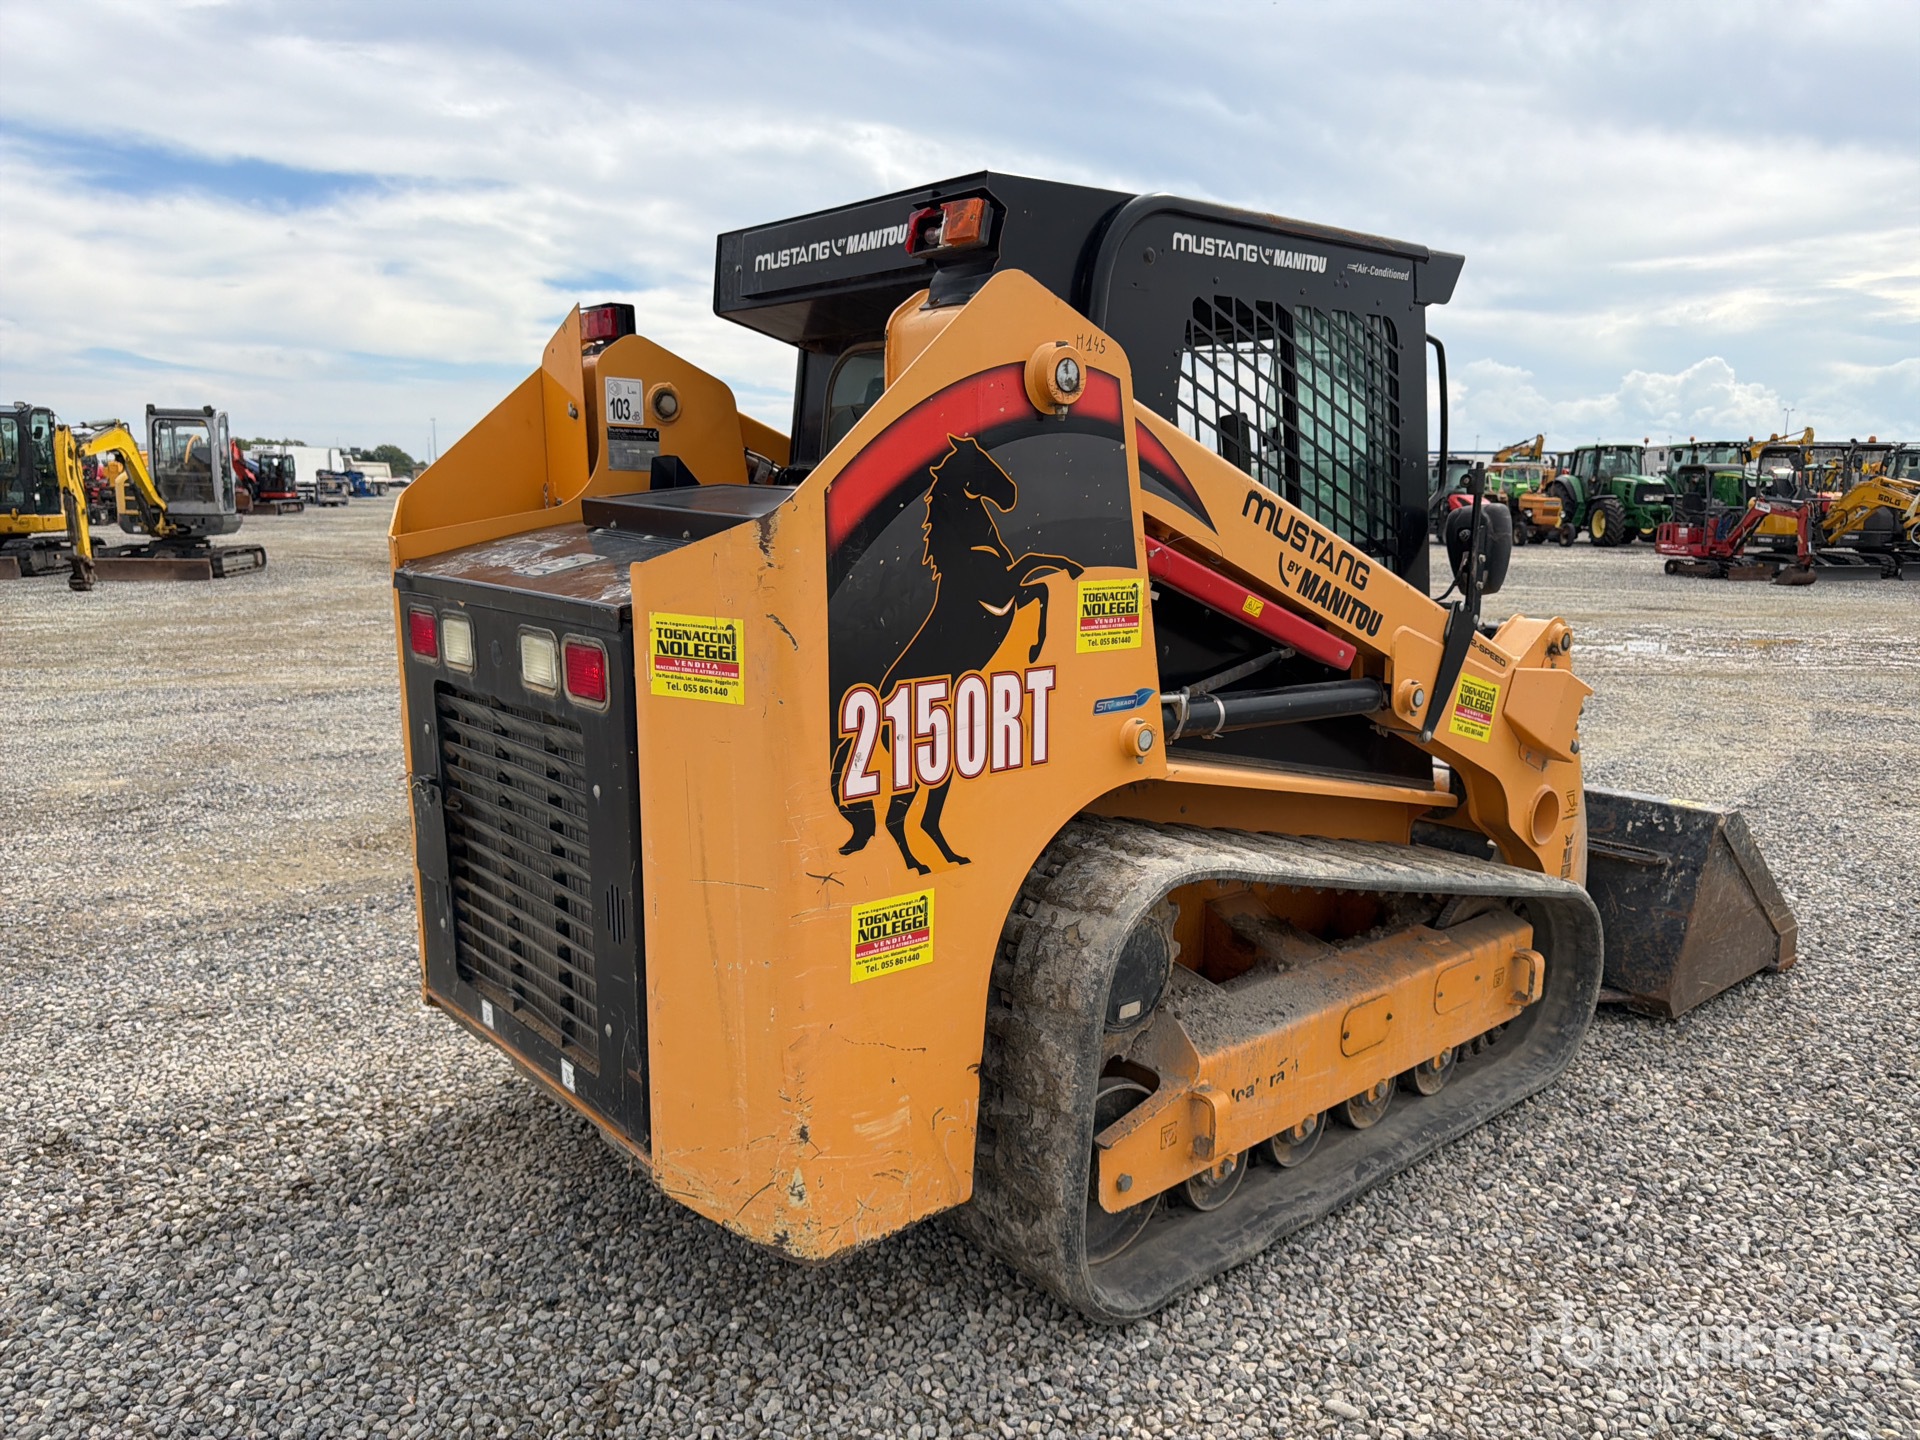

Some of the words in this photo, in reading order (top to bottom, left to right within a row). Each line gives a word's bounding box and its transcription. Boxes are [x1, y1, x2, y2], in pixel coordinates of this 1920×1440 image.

[754, 240, 830, 272] MUSTANG
[838, 238, 847, 247] BY
[846, 223, 909, 255] MANITOU
[1172, 231, 1258, 263] MUSTANG
[1264, 248, 1273, 257] BY
[1273, 249, 1328, 274] MANITOU
[1357, 263, 1410, 281] Air-Conditioned
[609, 397, 631, 420] 103
[1241, 489, 1371, 592] MUSTANG
[1286, 560, 1302, 576] BY
[1295, 567, 1384, 637] MANITOU
[1094, 617, 1126, 625] VENDITA
[1100, 637, 1110, 645] 055
[1111, 636, 1131, 645] 861440
[1470, 638, 1507, 668] 2-SPEED
[674, 659, 719, 670] VENDITA
[666, 681, 682, 691] Tel.
[683, 683, 698, 693] 055
[699, 685, 728, 696] 861440
[1115, 699, 1135, 707] READY
[841, 664, 1056, 802] 2150RT
[874, 934, 913, 949] VENDITA
[865, 962, 880, 973] Tel.
[881, 959, 894, 970] 055
[895, 952, 920, 966] 861440
